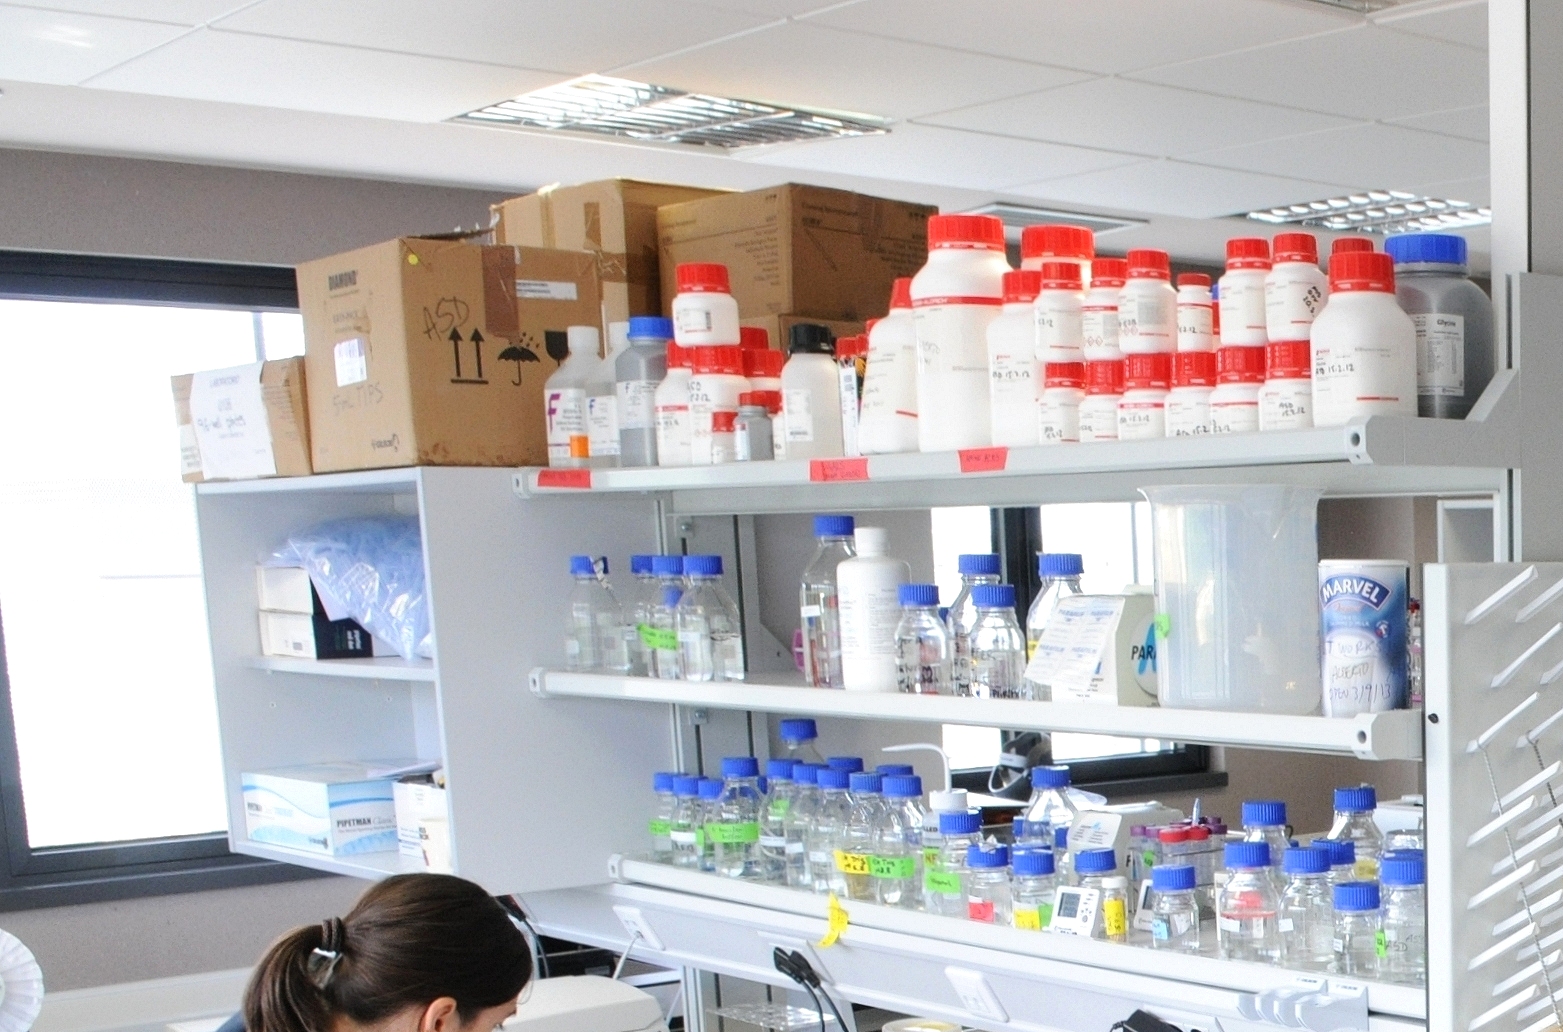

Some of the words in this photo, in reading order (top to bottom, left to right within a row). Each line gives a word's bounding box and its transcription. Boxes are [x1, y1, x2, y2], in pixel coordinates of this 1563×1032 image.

[423, 296, 470, 341] ASD
[1322, 577, 1379, 604] MARVEL
[337, 816, 372, 829] PIPETMAN
